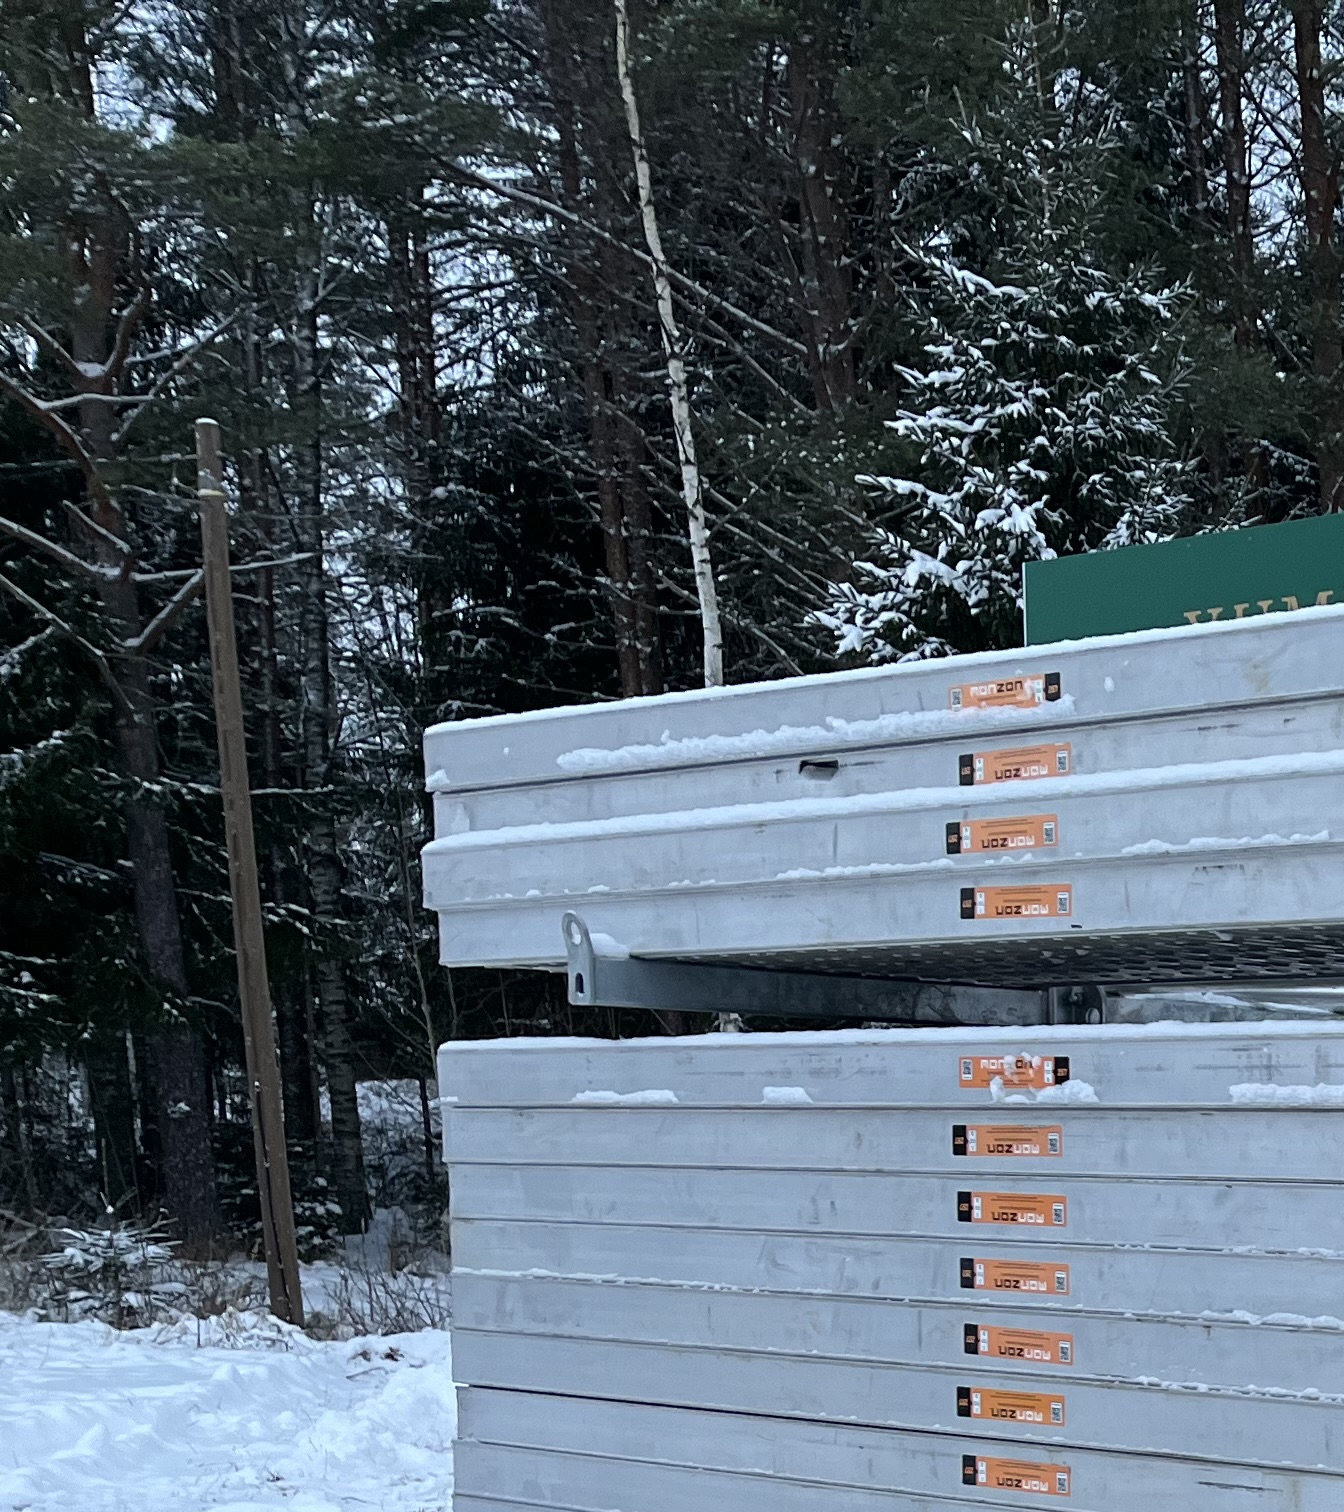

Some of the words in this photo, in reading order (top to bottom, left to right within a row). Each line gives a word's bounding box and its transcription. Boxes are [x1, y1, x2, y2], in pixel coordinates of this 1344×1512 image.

[970, 680, 1023, 697] monzon
[995, 766, 1048, 780] monzon
[981, 835, 1035, 849] monzon
[995, 904, 1049, 916] monzon
[987, 1143, 1040, 1154] monzon
[991, 1211, 1044, 1223] monzon
[994, 1278, 1047, 1291] monzon
[998, 1345, 1051, 1360] monzon
[990, 1407, 1043, 1421] monzon
[995, 1476, 1049, 1491] monzon
